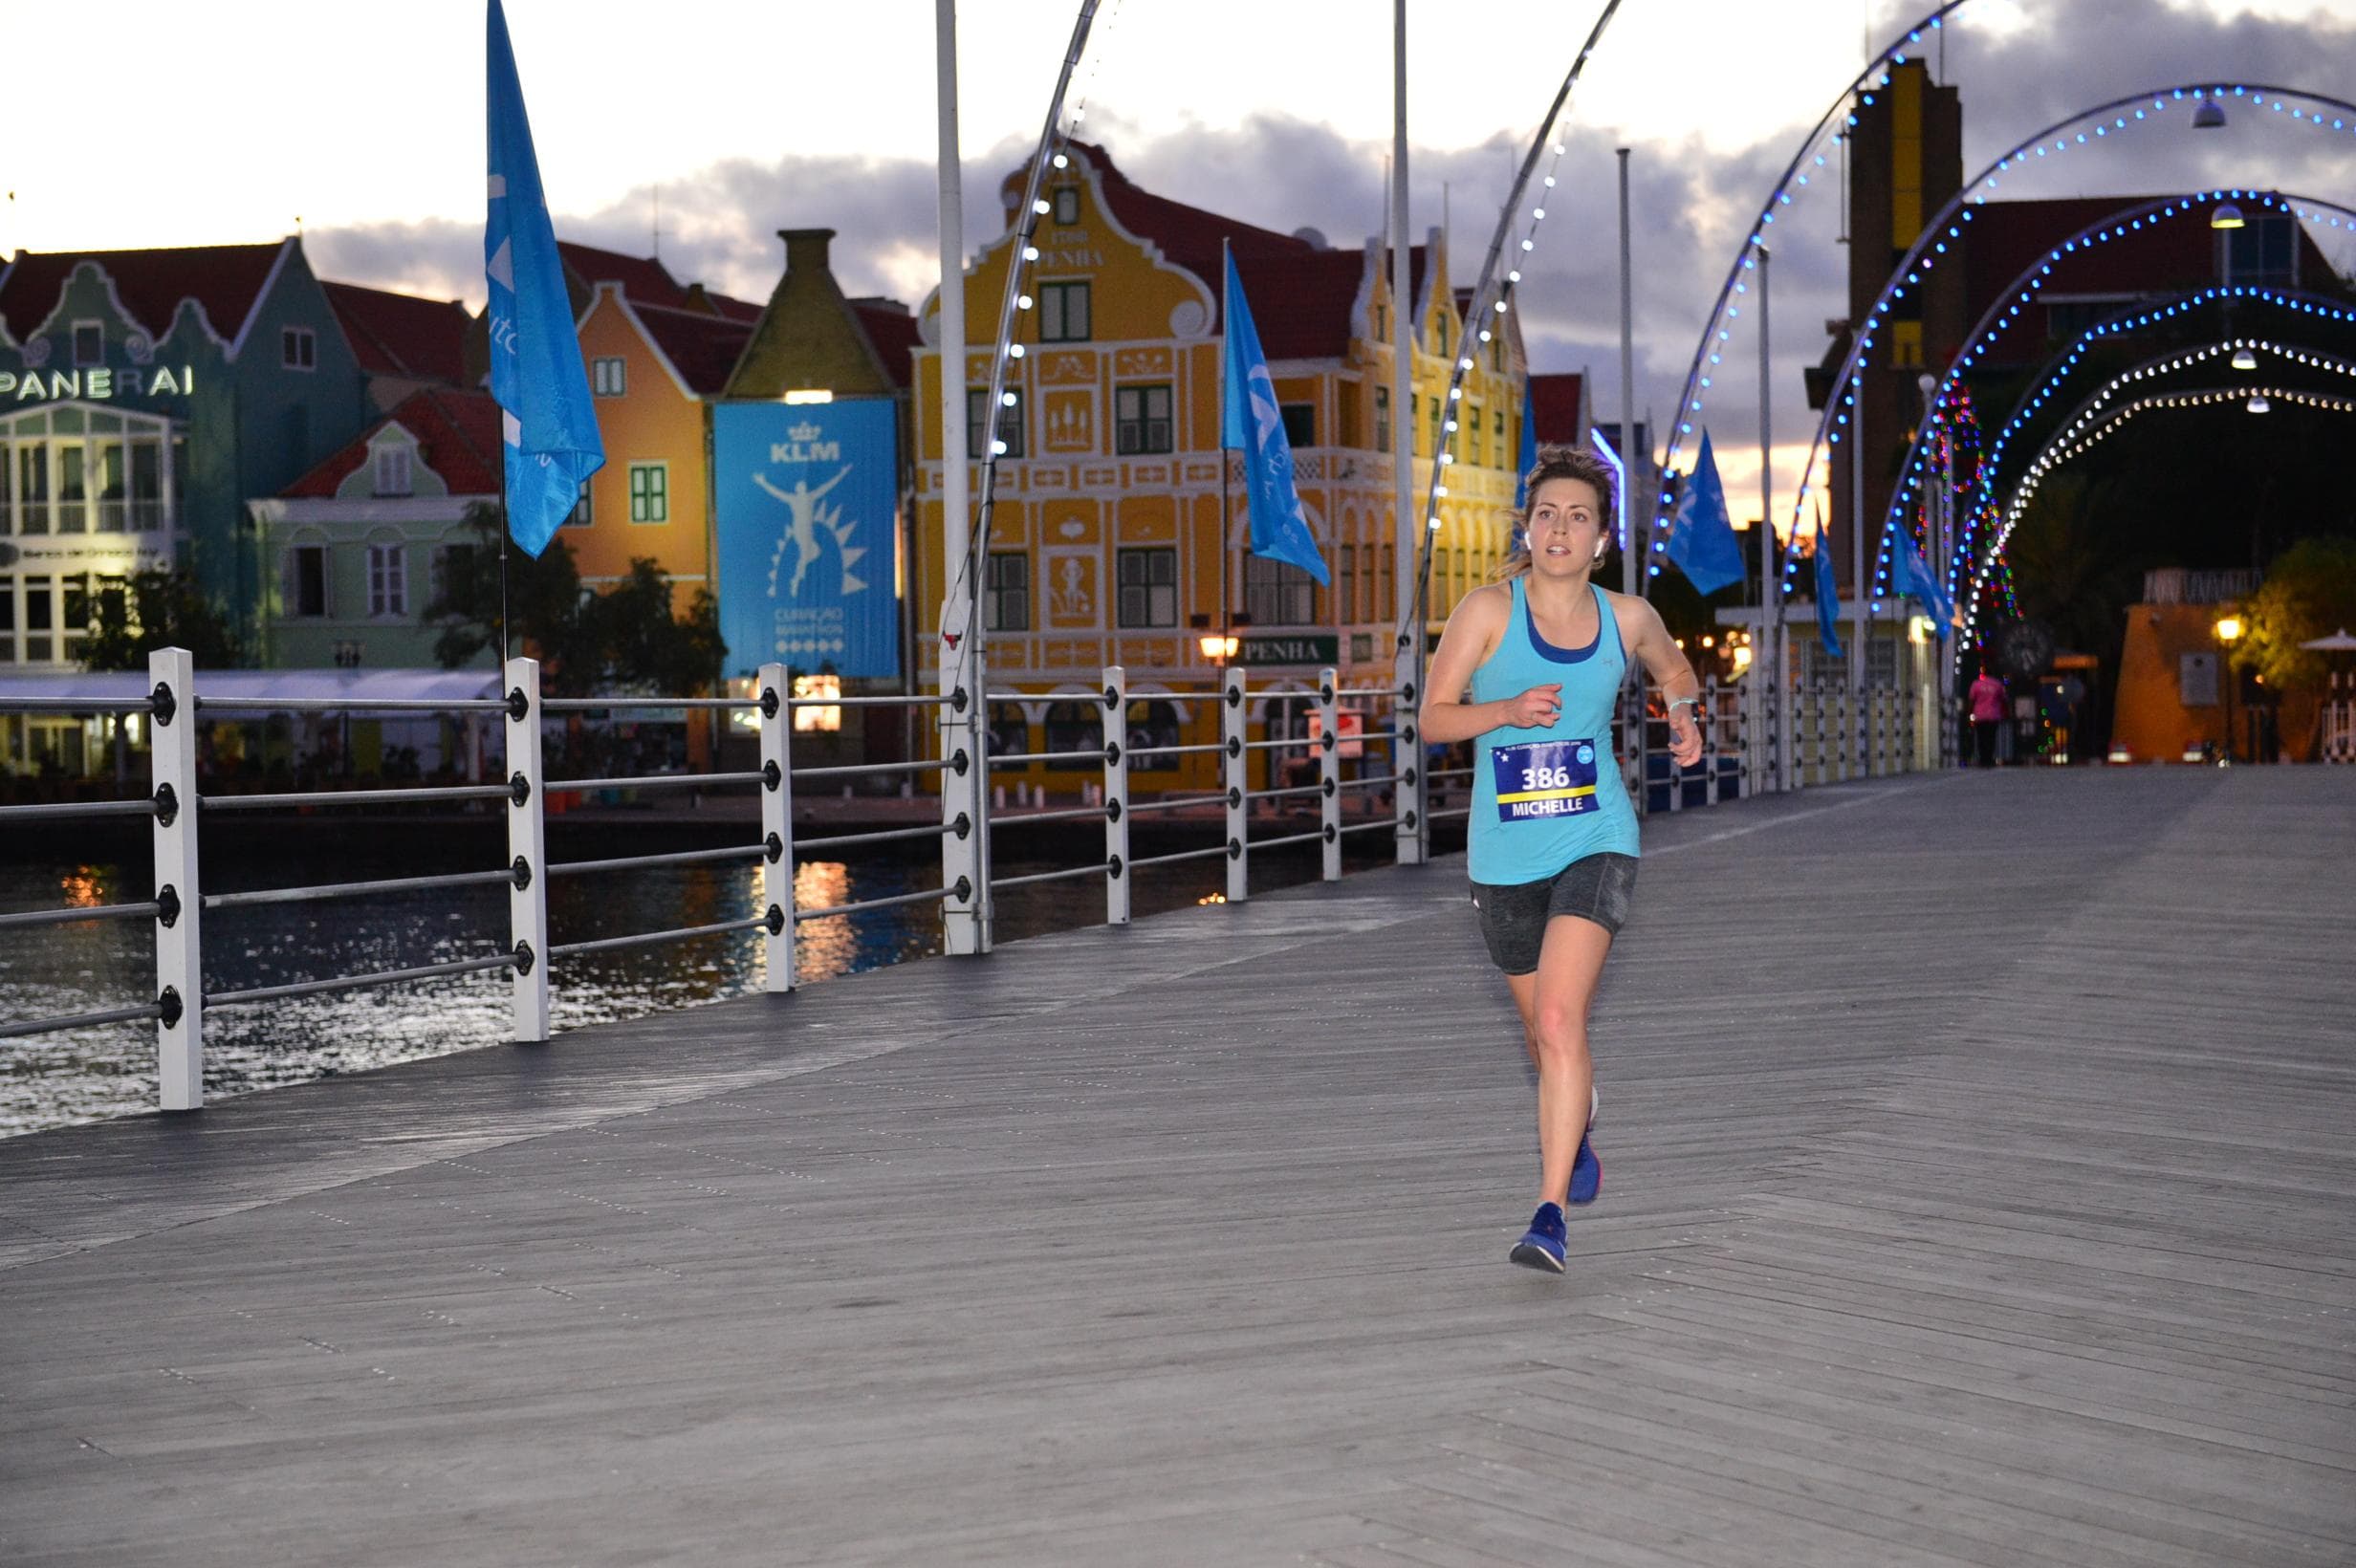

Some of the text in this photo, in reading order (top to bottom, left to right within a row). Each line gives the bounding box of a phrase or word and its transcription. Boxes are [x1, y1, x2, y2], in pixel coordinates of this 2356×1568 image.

[771, 442, 840, 464] KLM
[1245, 642, 1320, 660] PENHA
[1521, 766, 1570, 791] 386
[1512, 797, 1583, 817] MICHELLE
